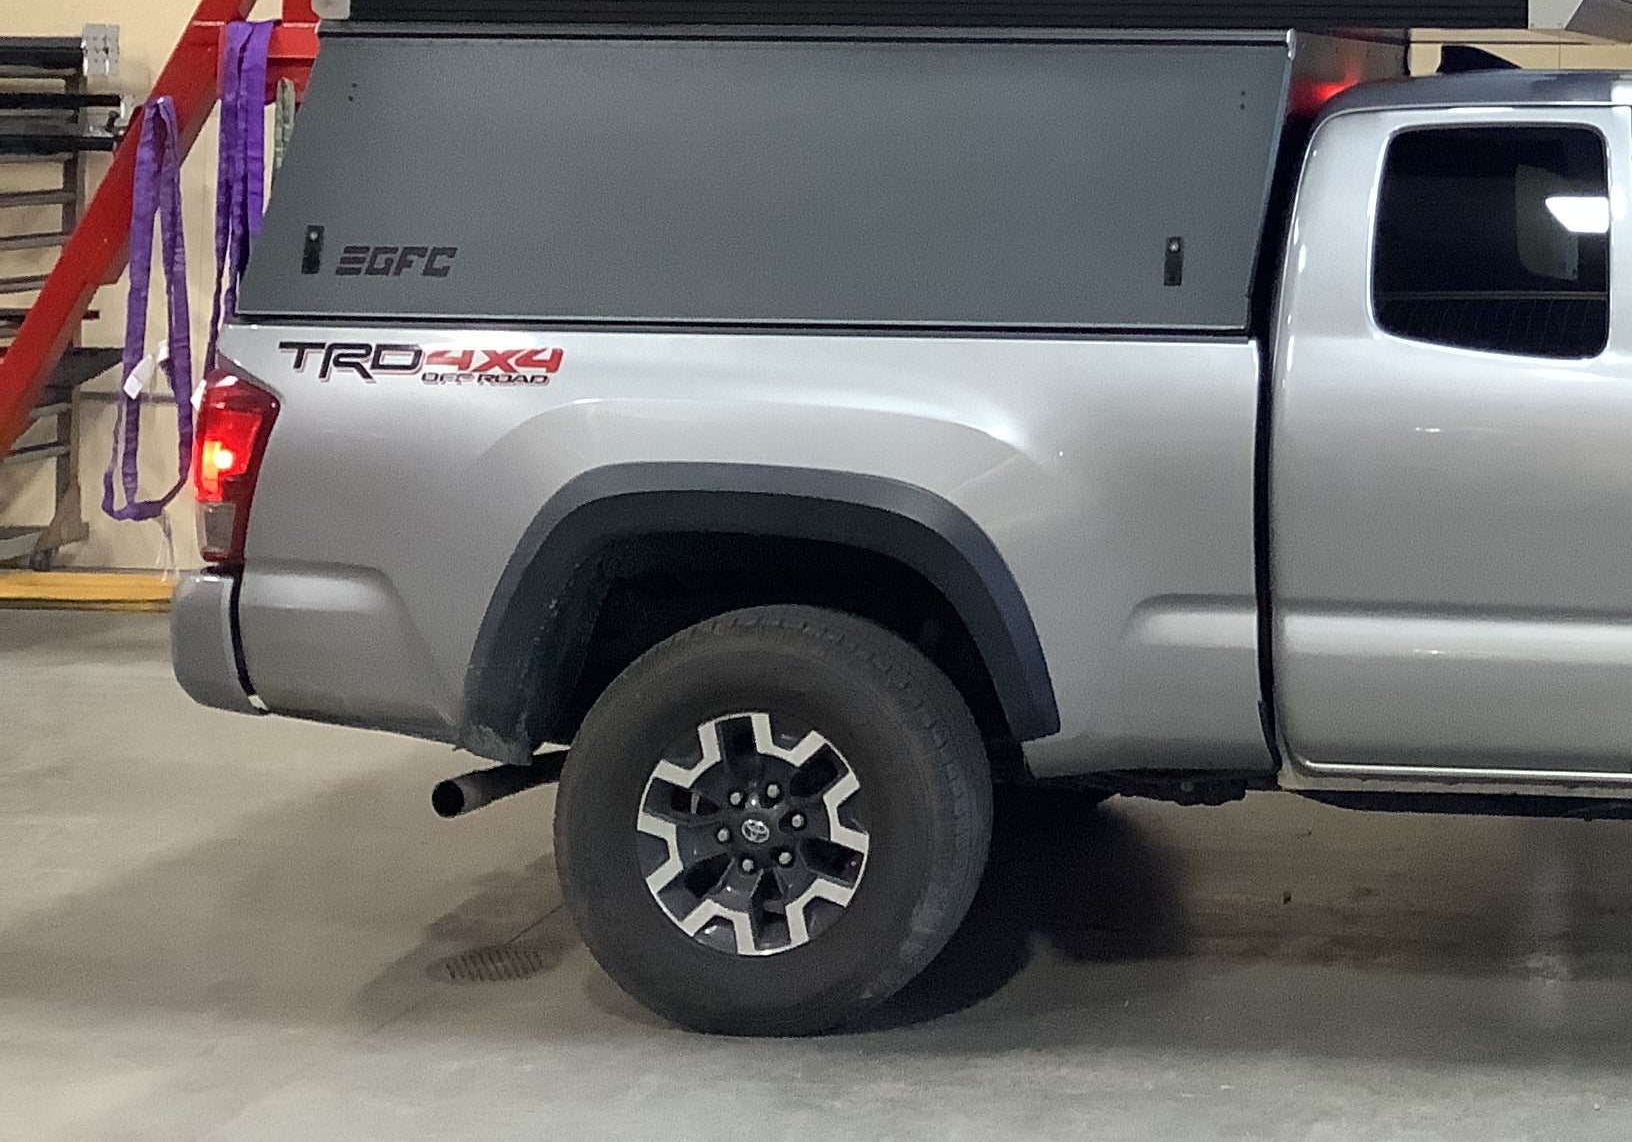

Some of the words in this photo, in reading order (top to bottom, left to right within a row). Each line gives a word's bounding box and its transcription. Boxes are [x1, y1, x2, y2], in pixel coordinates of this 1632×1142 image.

[278, 341, 426, 384] TRD
[421, 371, 475, 386] OFF
[476, 373, 551, 387] ROAD
